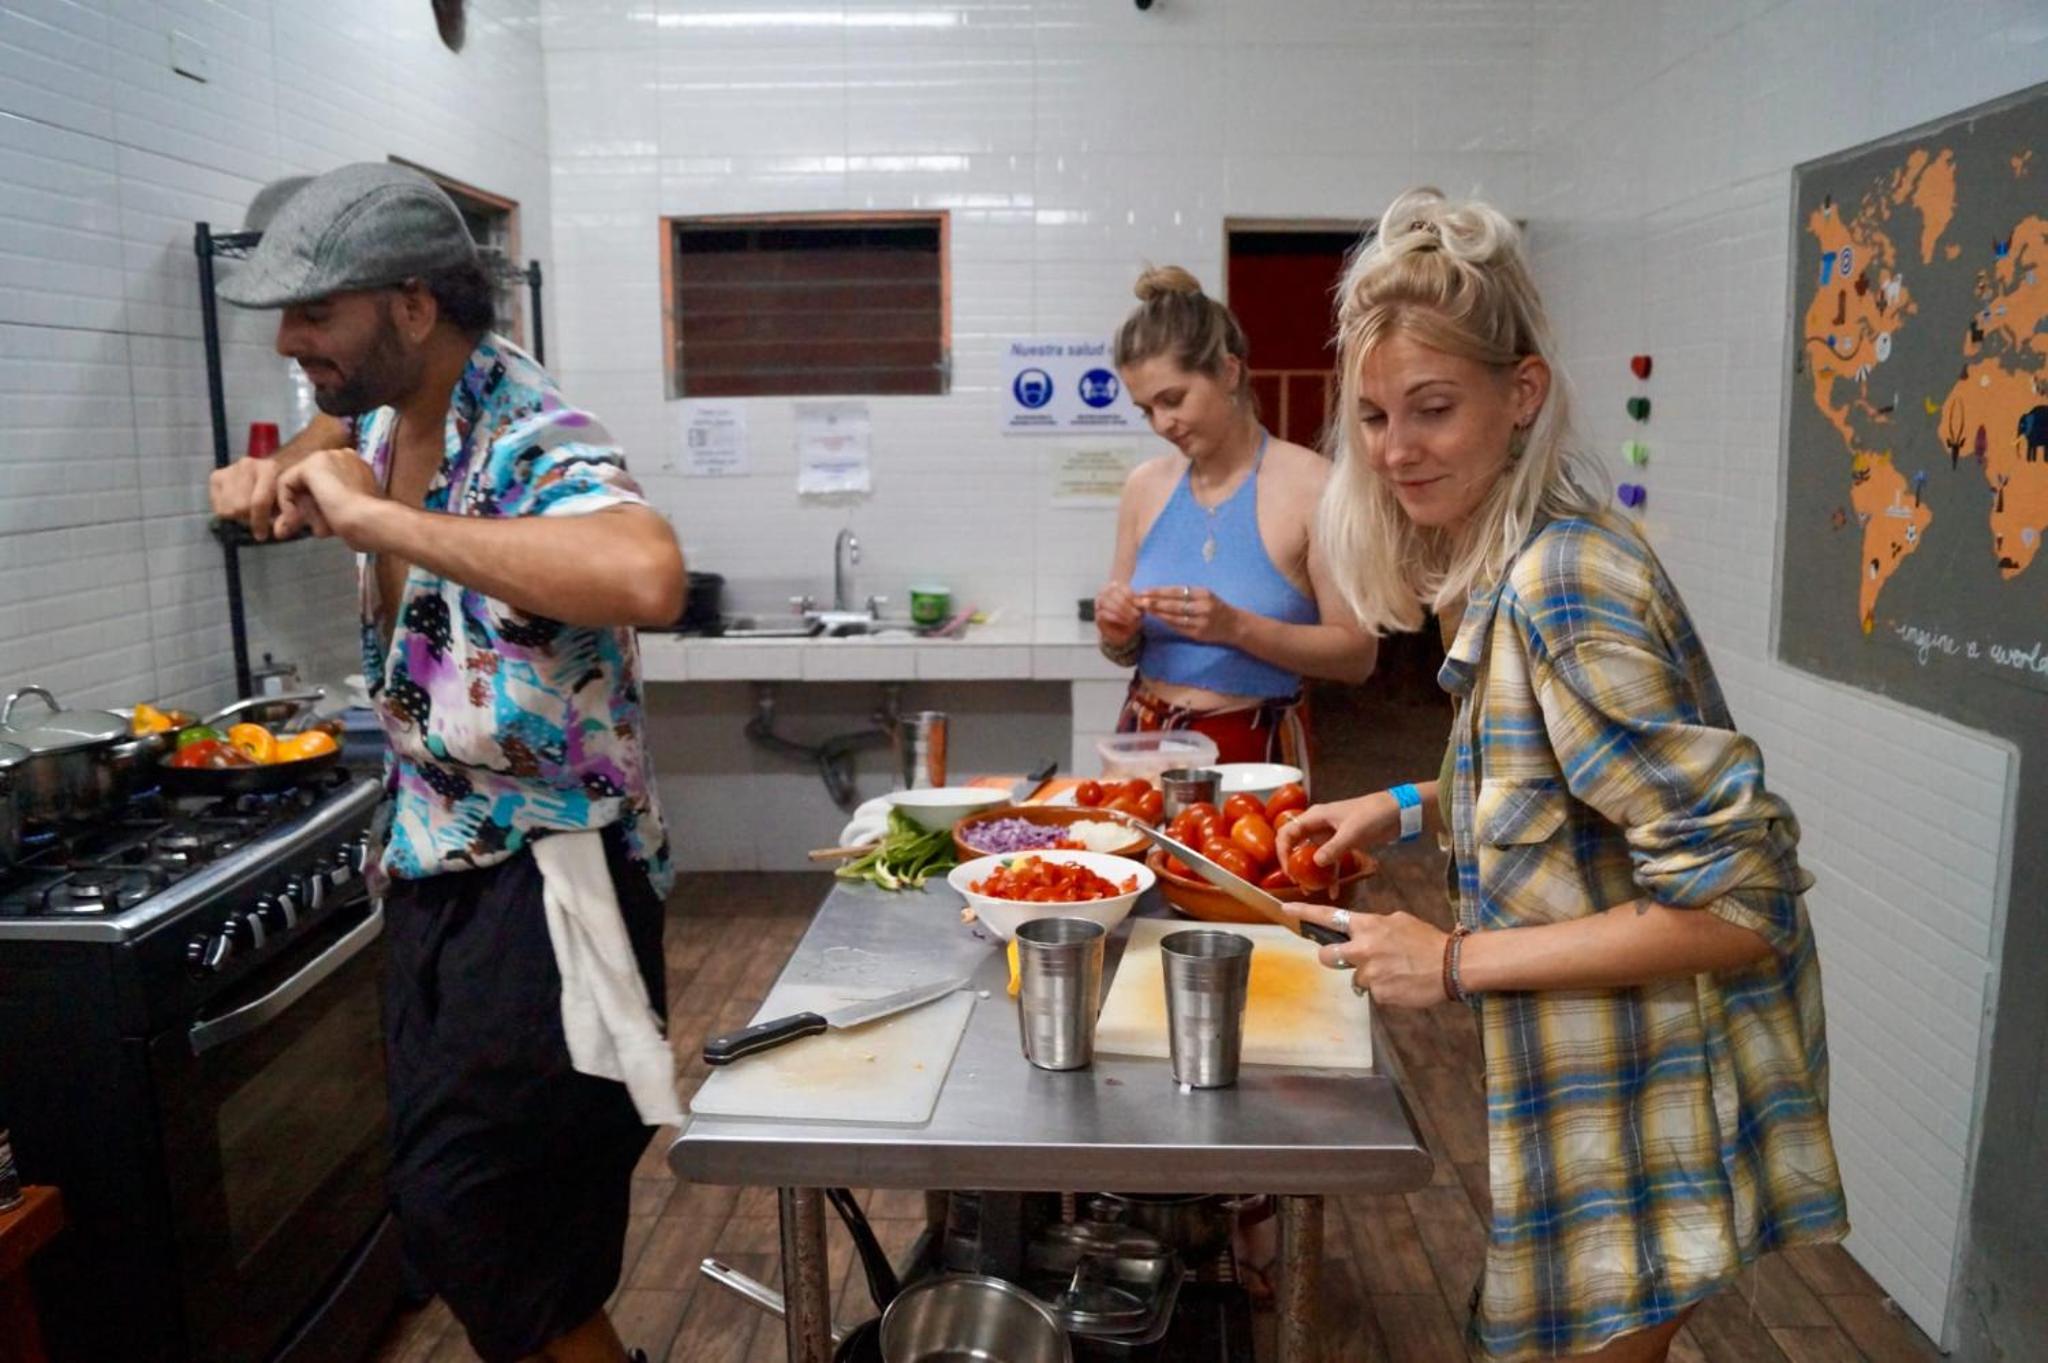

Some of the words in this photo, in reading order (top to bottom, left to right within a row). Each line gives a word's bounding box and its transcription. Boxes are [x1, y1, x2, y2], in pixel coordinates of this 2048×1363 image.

[1010, 343, 1063, 357] Nuestra
[1067, 342, 1105, 357] salud
[1966, 641, 1981, 659] a
